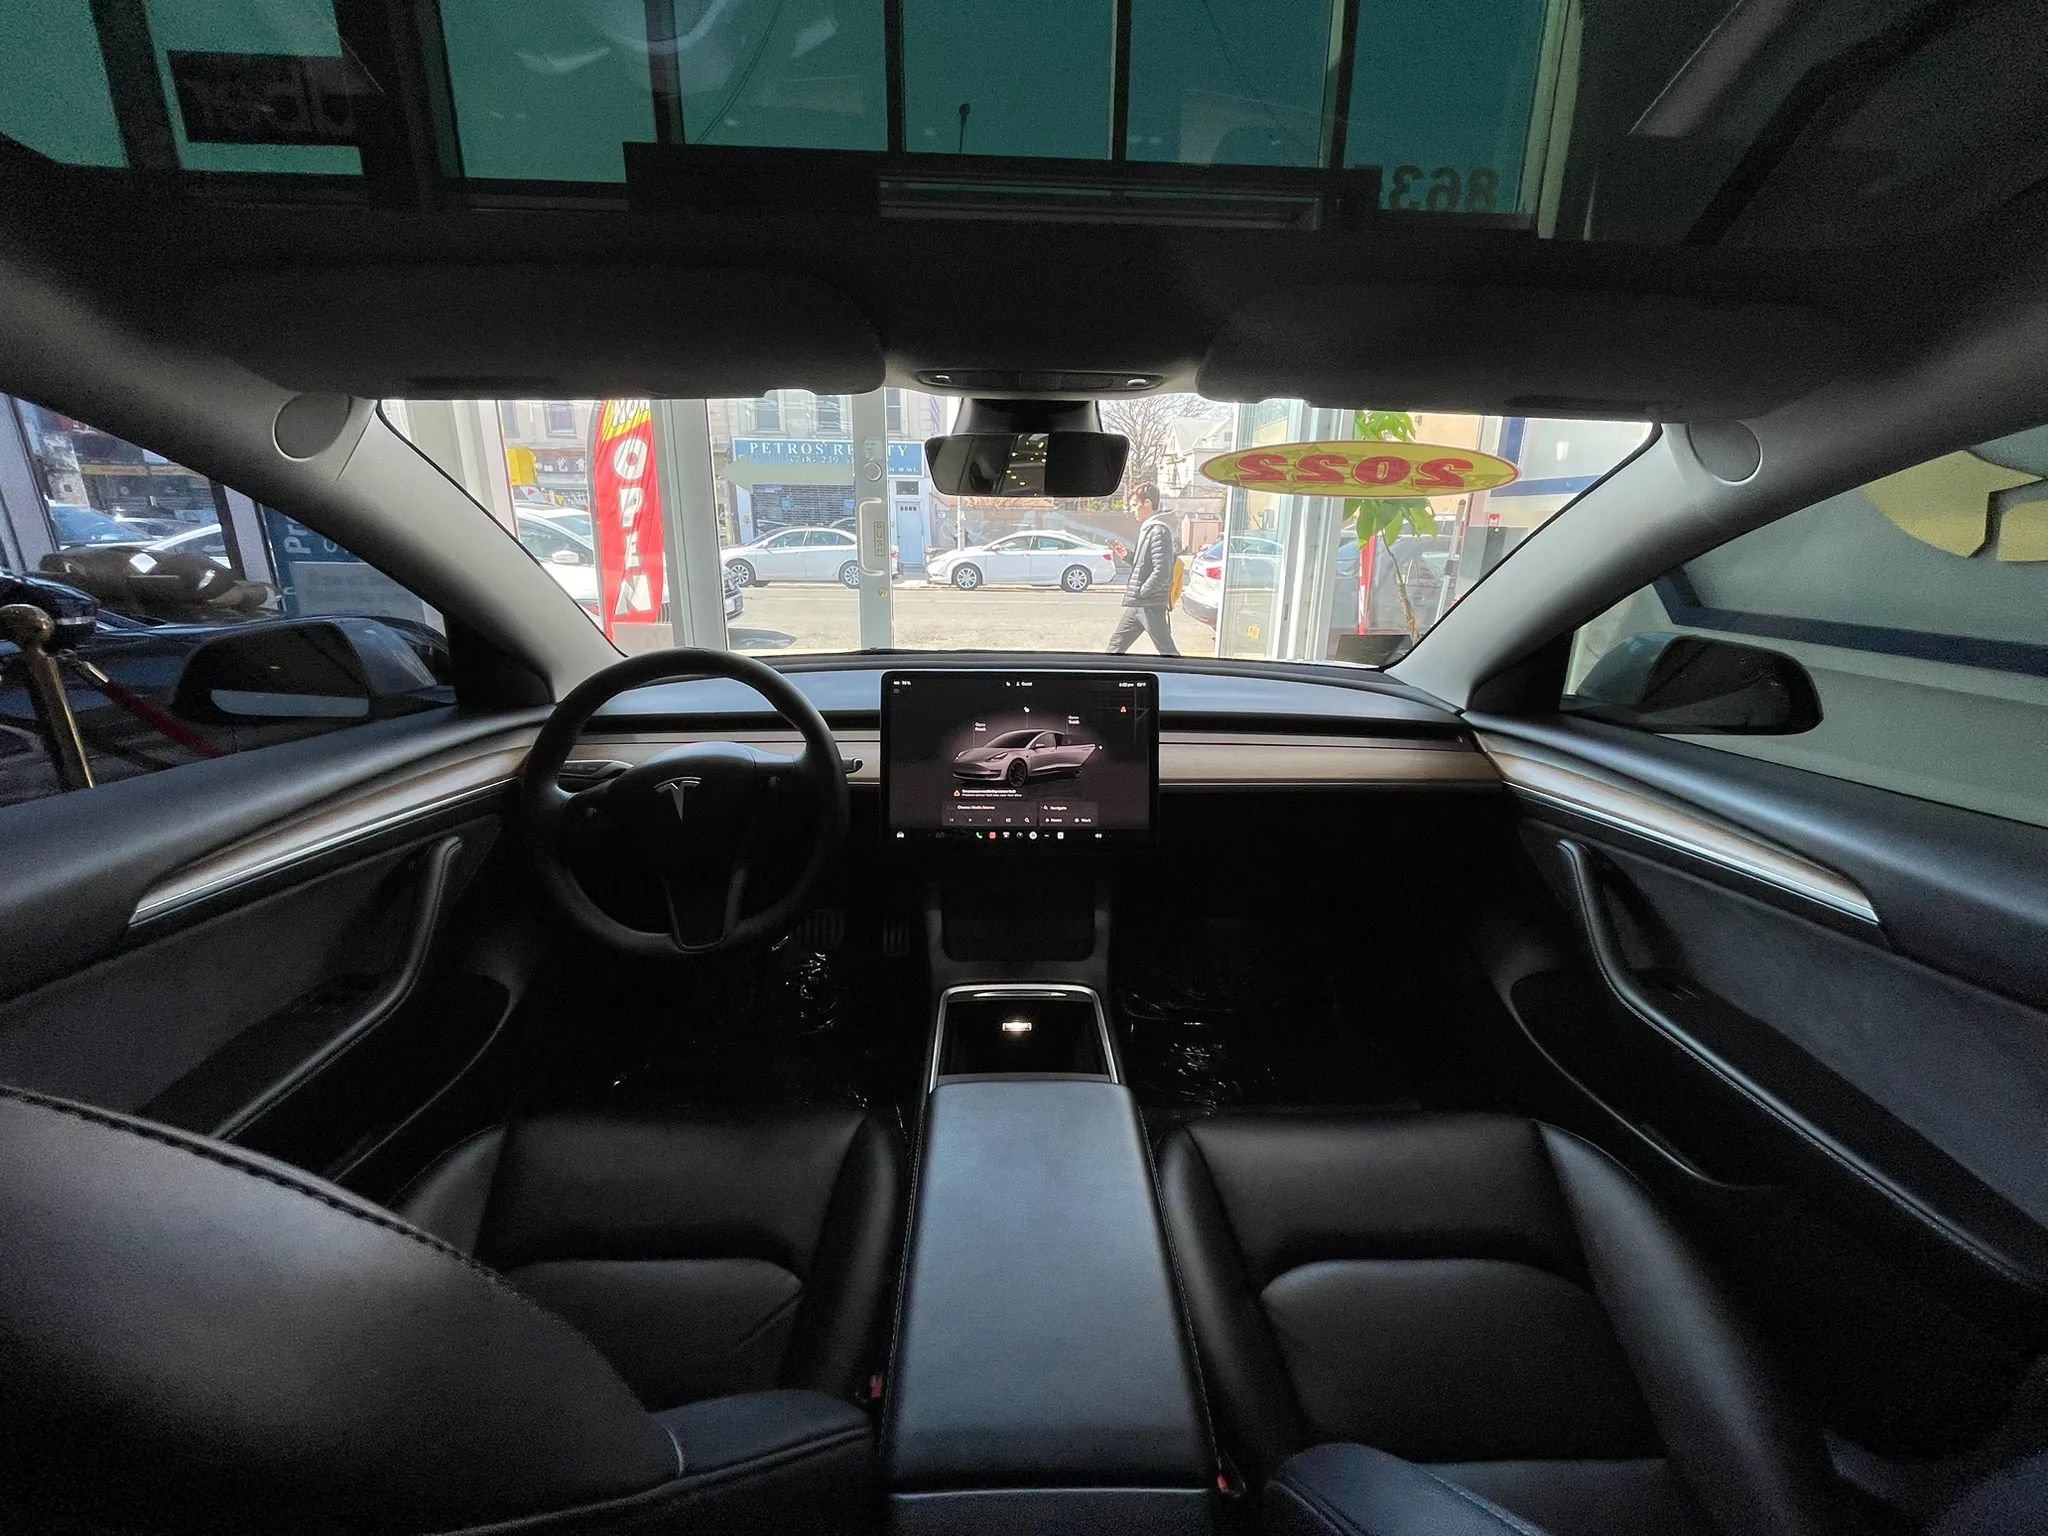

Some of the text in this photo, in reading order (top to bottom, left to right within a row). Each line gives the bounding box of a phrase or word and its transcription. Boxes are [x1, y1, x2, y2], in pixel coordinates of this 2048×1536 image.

[833, 443, 909, 456] RETY
[283, 516, 312, 555] Pr
[612, 437, 652, 615] OPEN
